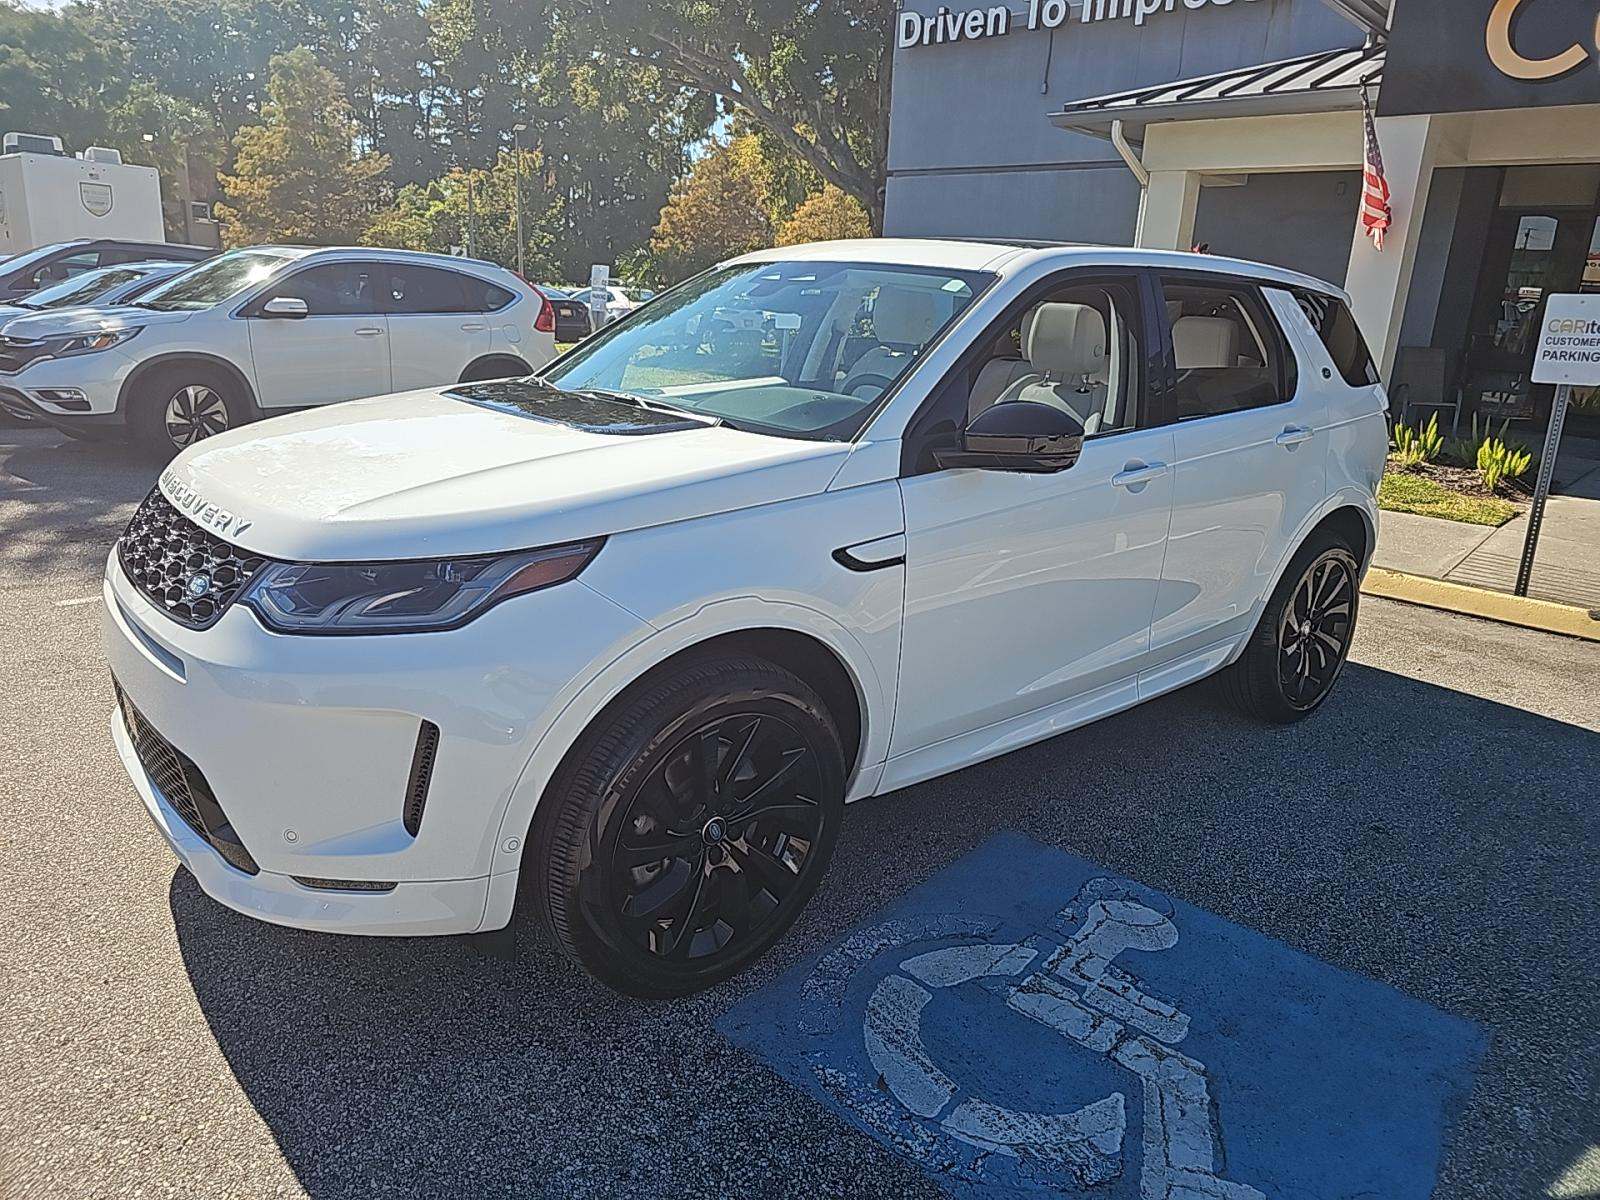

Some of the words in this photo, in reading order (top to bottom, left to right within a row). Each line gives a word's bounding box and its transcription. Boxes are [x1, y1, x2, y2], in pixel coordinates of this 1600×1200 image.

[898, 6, 1008, 49] Driven
[1024, 0, 1068, 30] To
[1541, 350, 1600, 363] PARKING
